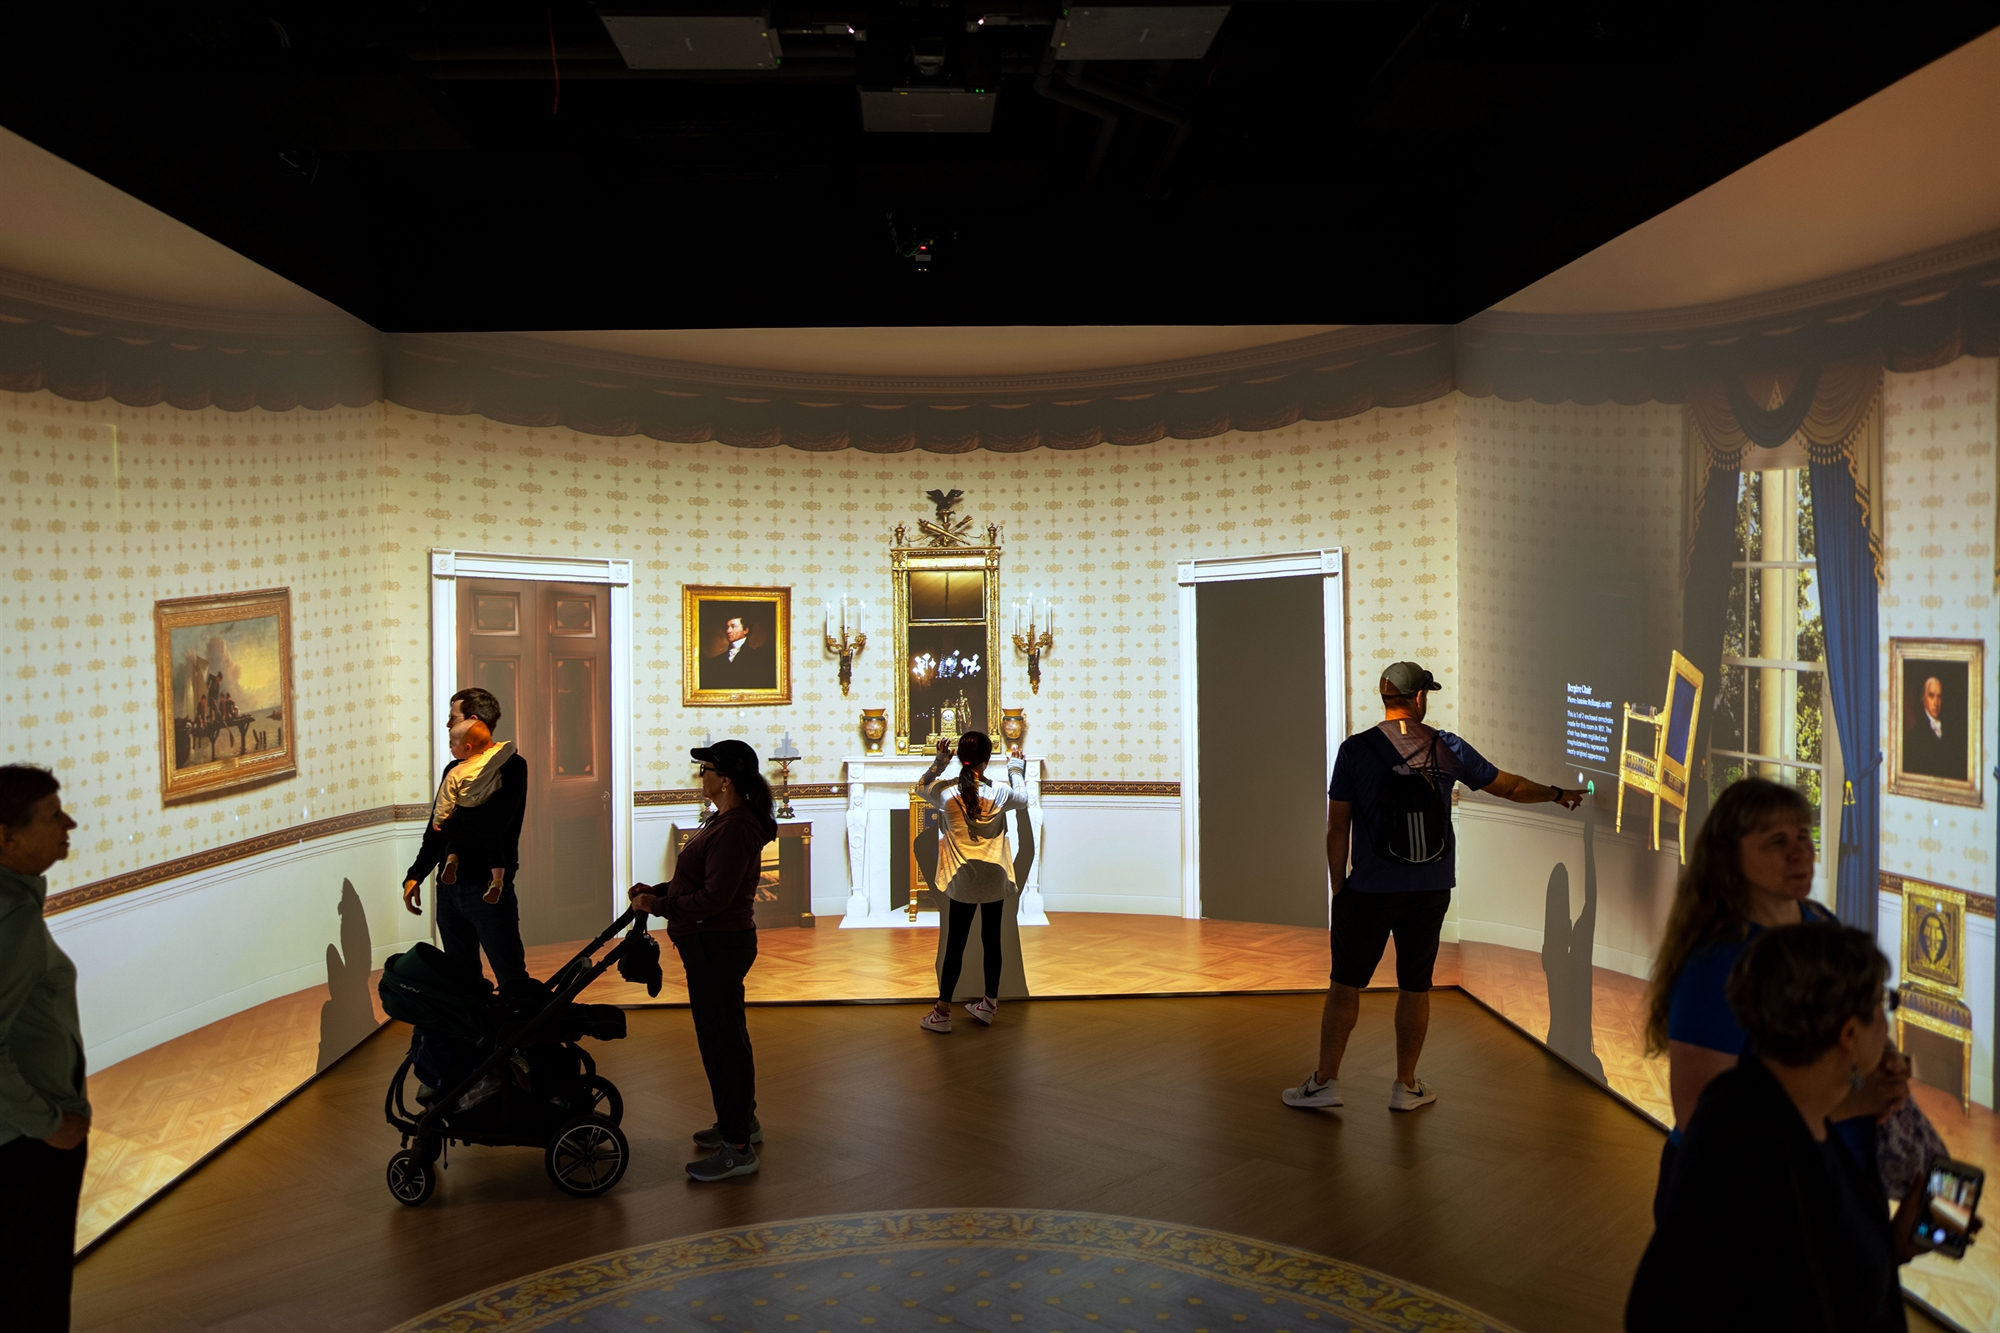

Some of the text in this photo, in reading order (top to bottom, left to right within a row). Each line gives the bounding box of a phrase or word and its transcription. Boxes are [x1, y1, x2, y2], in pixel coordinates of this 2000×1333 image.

[1582, 685, 1592, 695] Chair
[1598, 716, 1613, 724] armchairs
[1577, 750, 1587, 759] original
